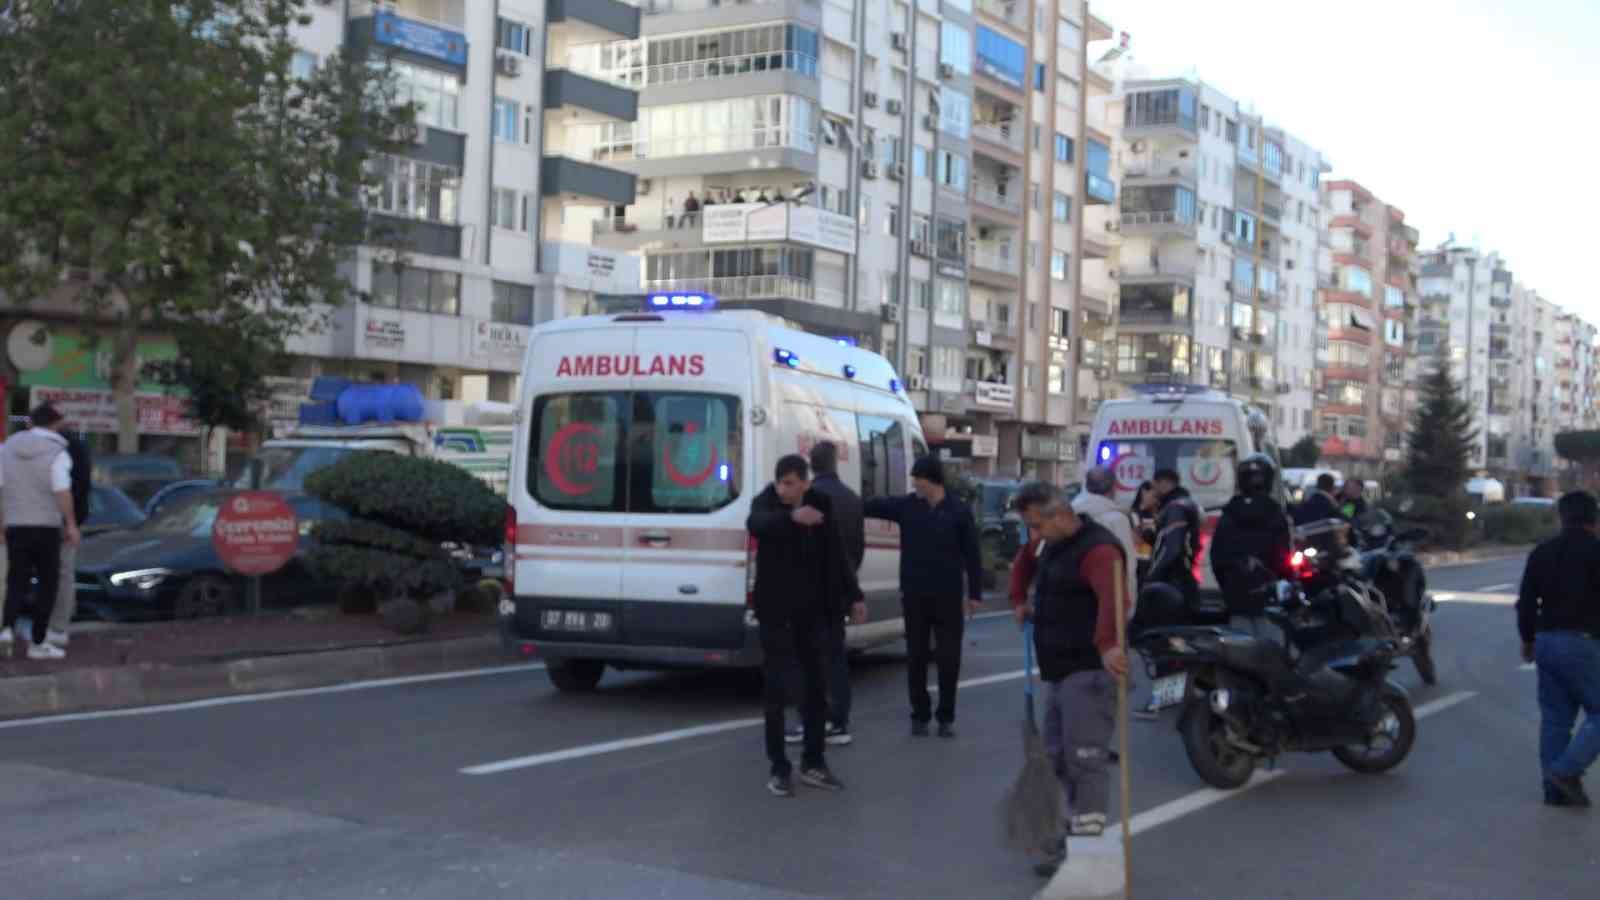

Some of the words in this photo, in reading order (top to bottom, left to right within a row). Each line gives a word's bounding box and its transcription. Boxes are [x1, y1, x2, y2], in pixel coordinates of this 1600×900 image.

[556, 354, 705, 377] AMBULANS
[1108, 418, 1224, 435] AMBULANS
[564, 443, 599, 473] 112
[1119, 464, 1145, 480] 112
